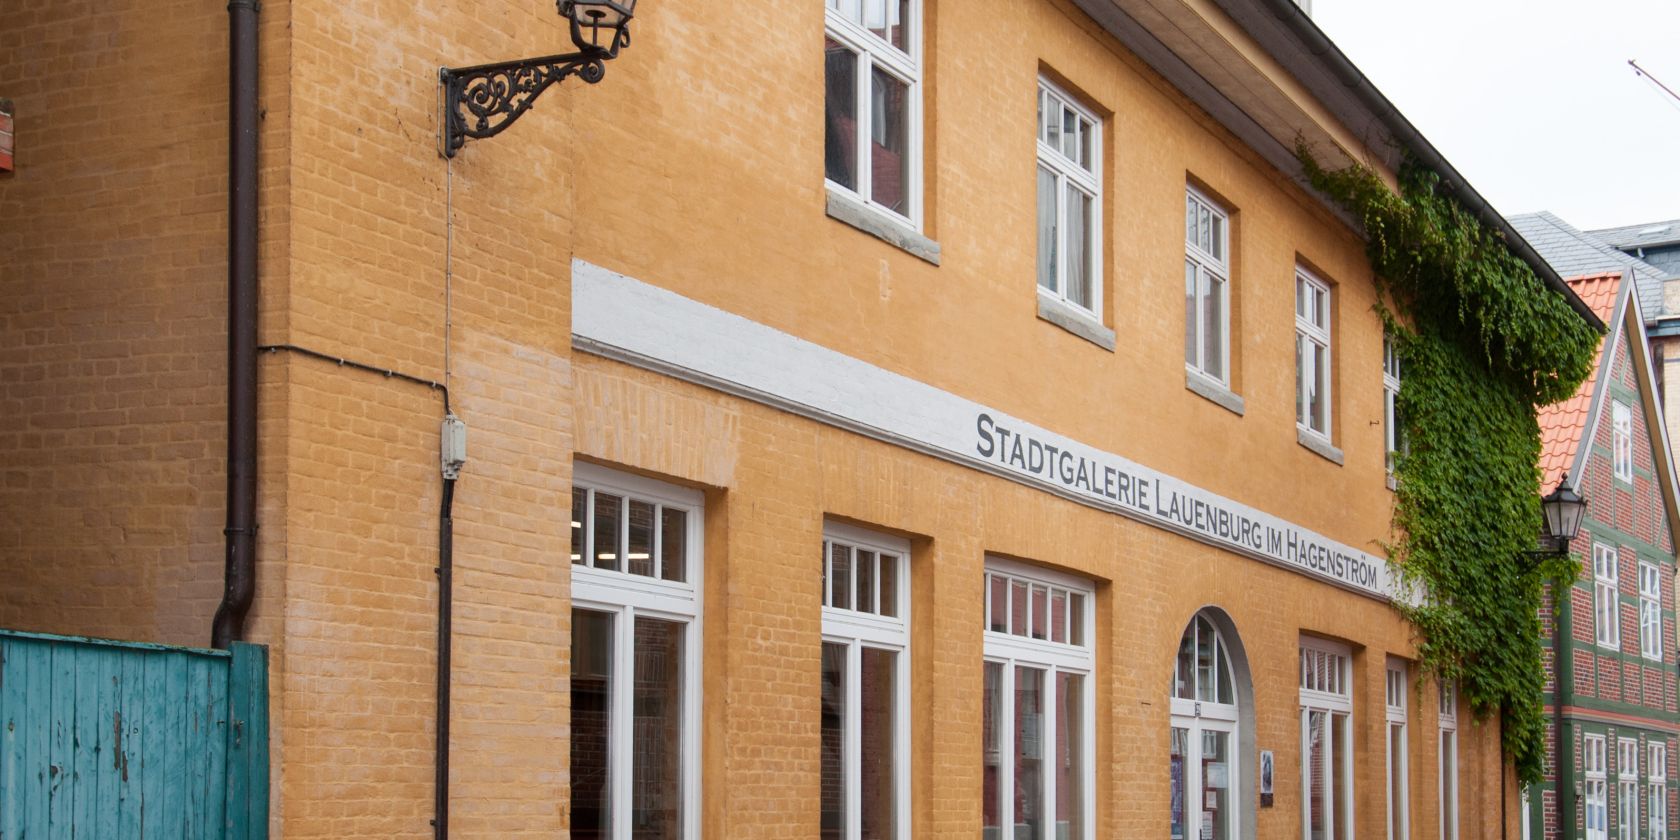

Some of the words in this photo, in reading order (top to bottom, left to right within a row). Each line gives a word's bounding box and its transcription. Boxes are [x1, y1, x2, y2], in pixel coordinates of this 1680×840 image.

[976, 413, 1150, 511] STADTGALERIE
[1155, 479, 1262, 549] LAUENBURG
[1266, 526, 1283, 557] IM
[1286, 528, 1377, 589] HAGENSTRÖM
